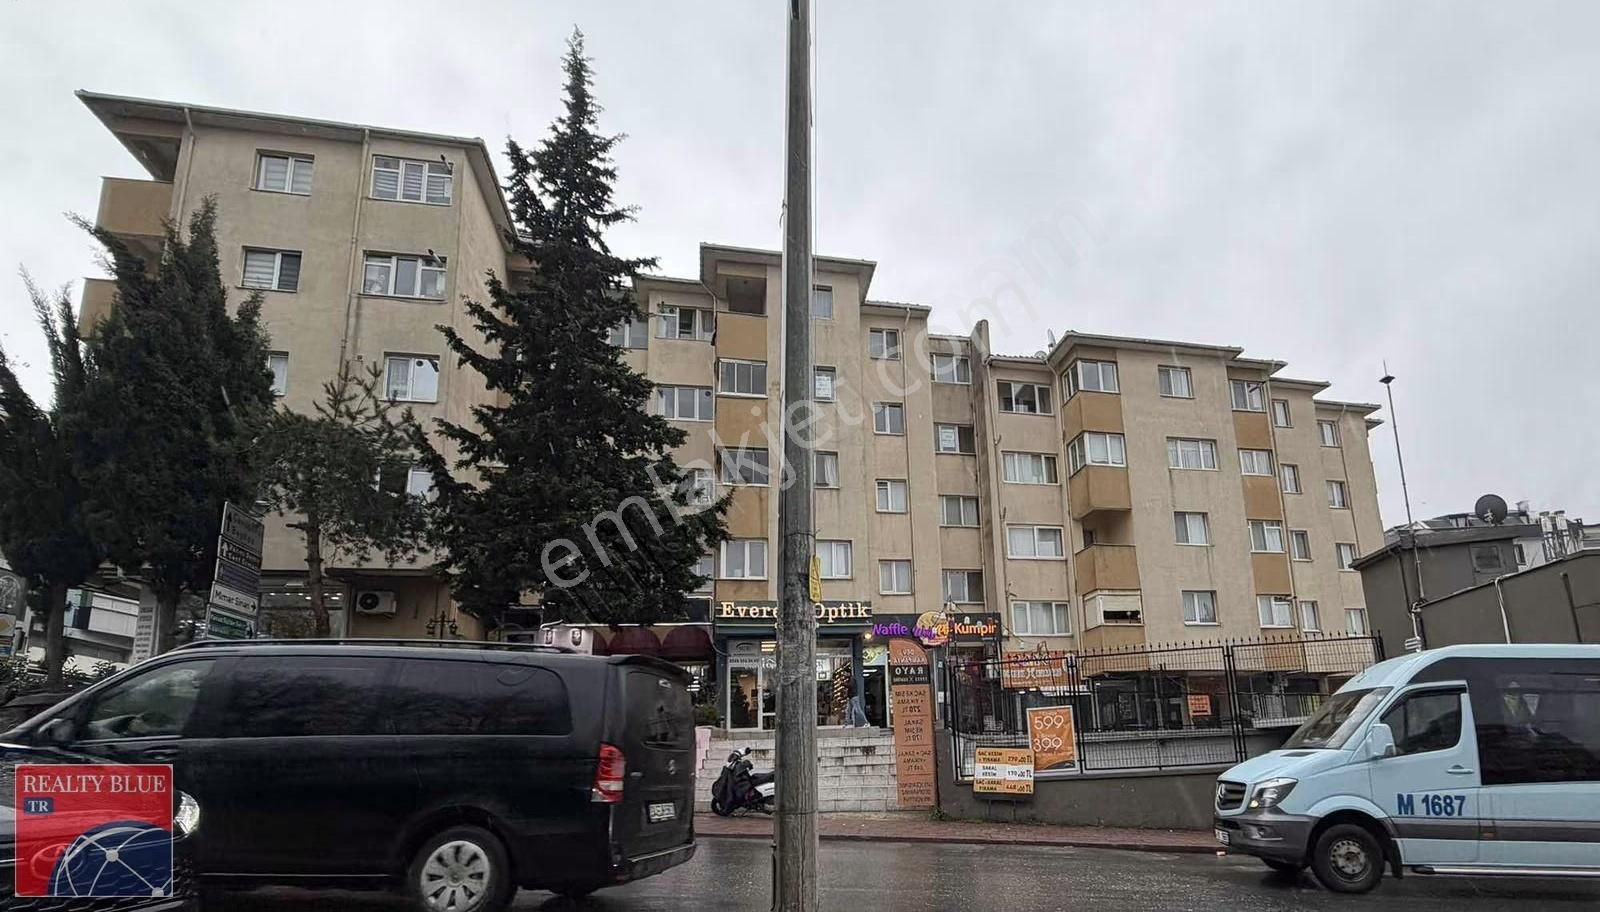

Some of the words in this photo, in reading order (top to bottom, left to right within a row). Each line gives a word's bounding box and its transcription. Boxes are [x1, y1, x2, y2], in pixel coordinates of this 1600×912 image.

[814, 603, 868, 623] Optik
[954, 623, 997, 636] Kumpir
[1034, 715, 1064, 730] 599
[1033, 737, 1063, 752] 399
[1397, 793, 1415, 815] M
[1421, 794, 1466, 816] 1687
